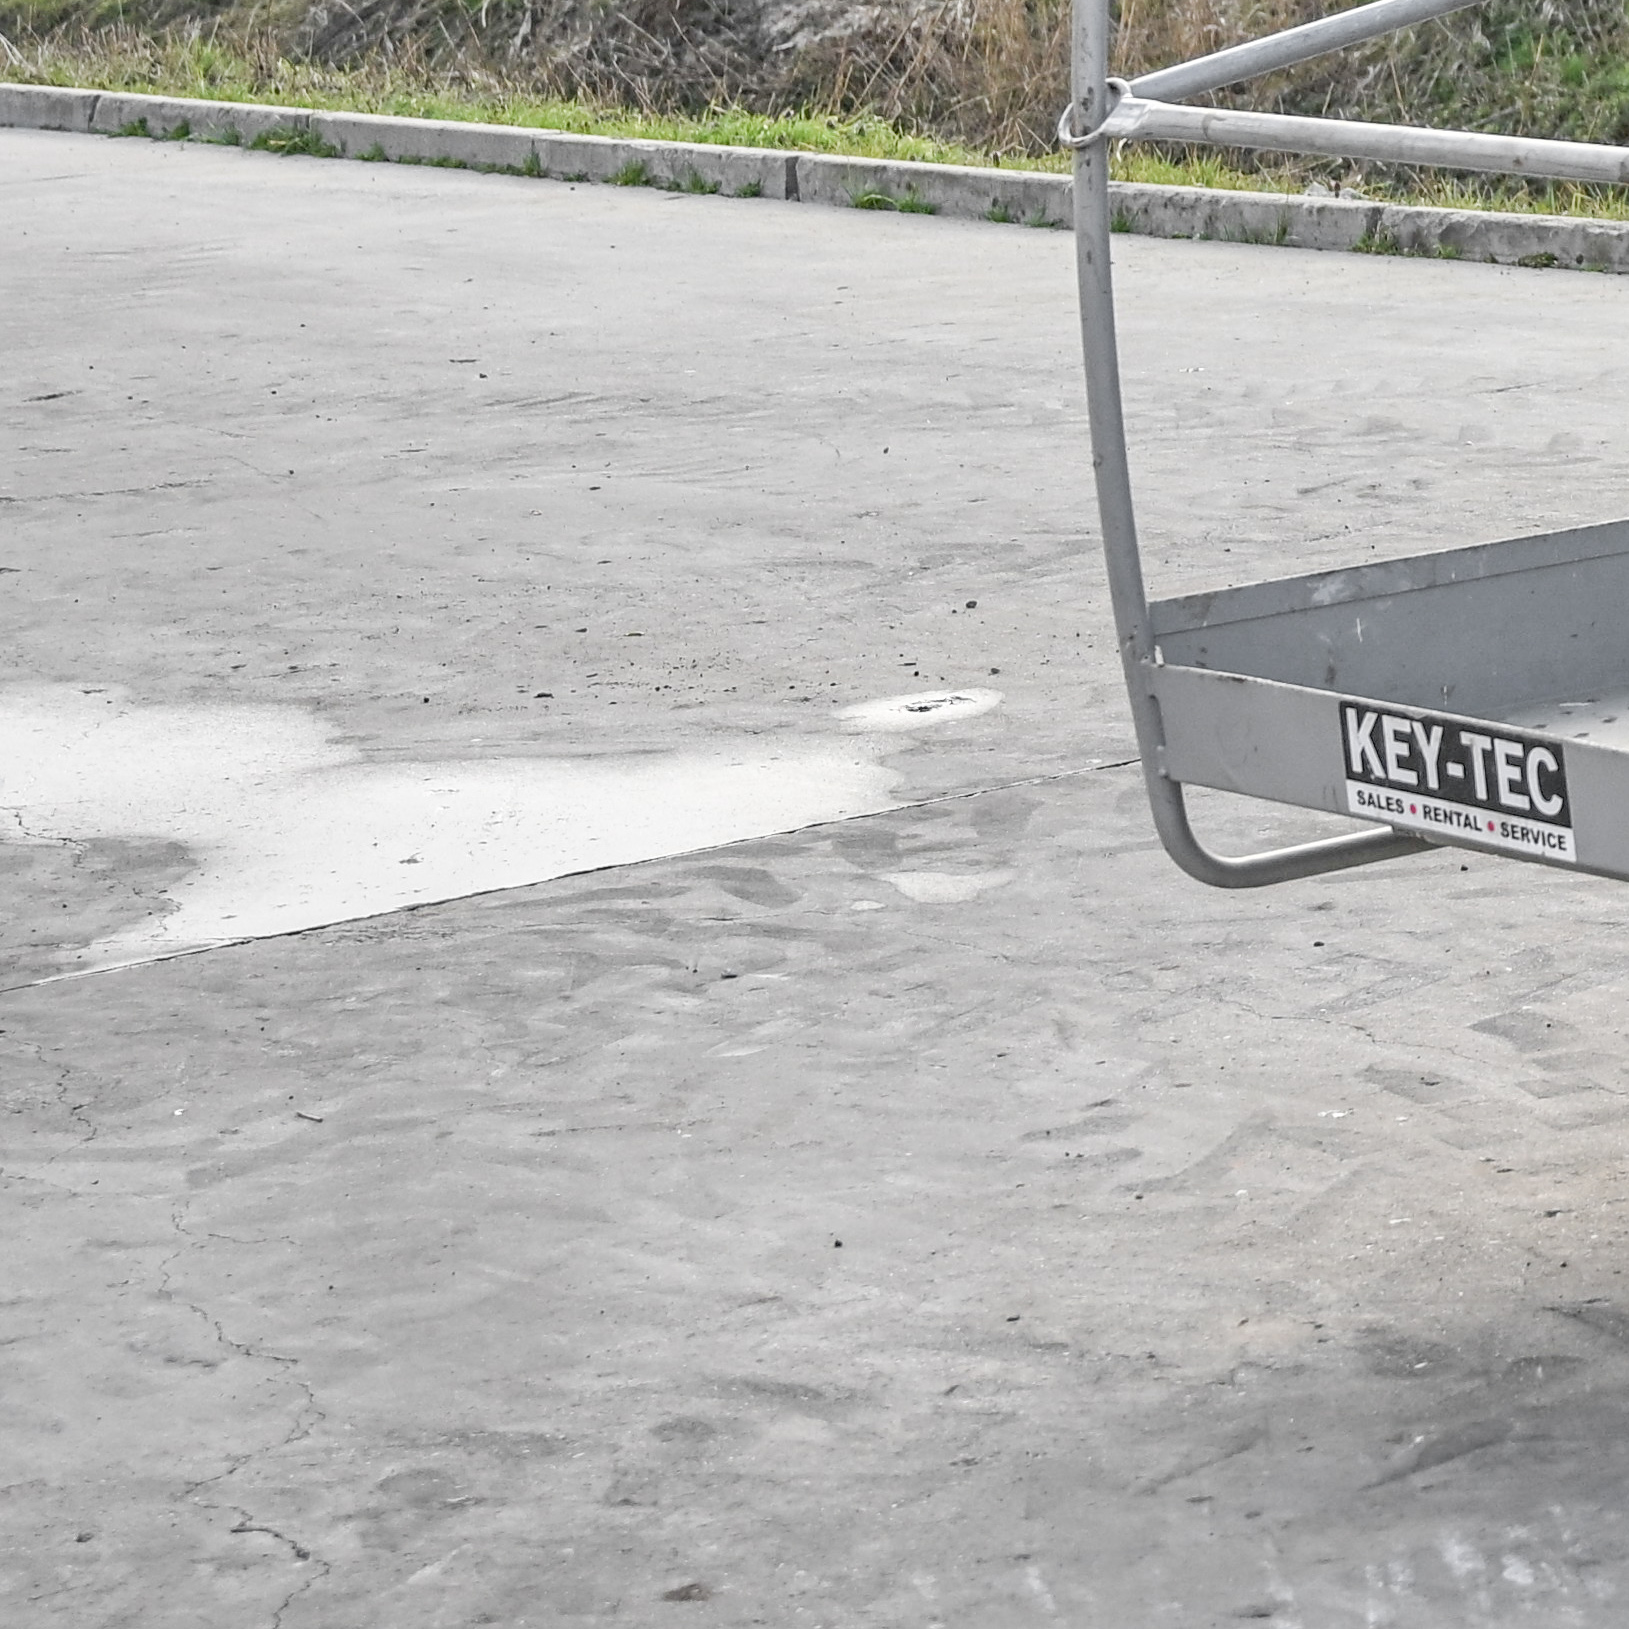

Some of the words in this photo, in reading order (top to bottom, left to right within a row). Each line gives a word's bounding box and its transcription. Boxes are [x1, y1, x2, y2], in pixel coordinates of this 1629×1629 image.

[1346, 707, 1563, 816] KEY-TEC
[1357, 789, 1404, 814] SALES
[1422, 803, 1482, 832] RENTAL
[1500, 822, 1568, 851] SERVICE
